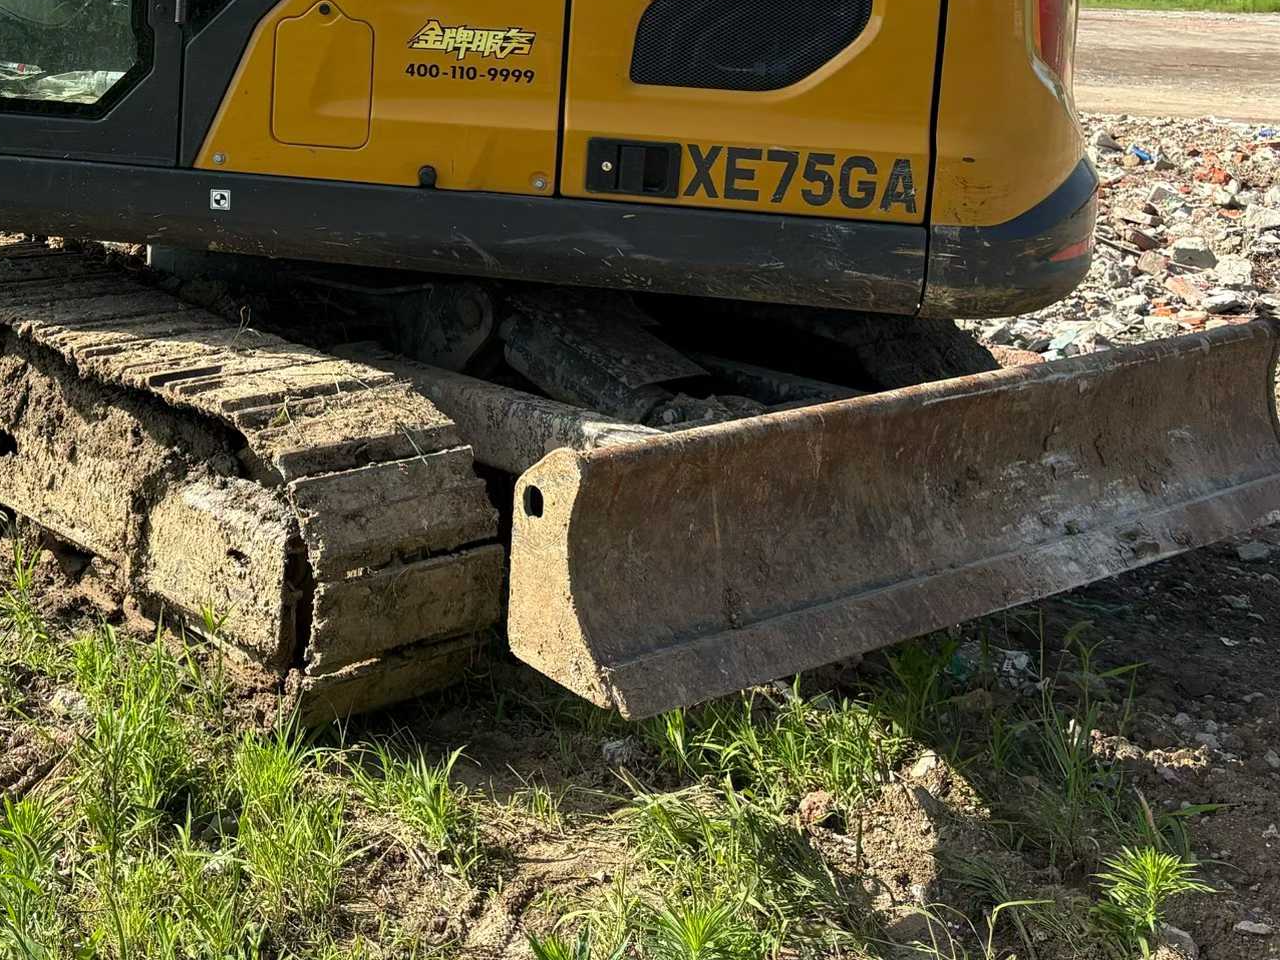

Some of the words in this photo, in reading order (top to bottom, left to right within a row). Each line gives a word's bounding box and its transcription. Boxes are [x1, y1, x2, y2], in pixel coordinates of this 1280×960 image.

[407, 19, 536, 60] 金牌服务
[405, 63, 535, 83] 400-110-9999
[682, 144, 917, 214] XE75GA
